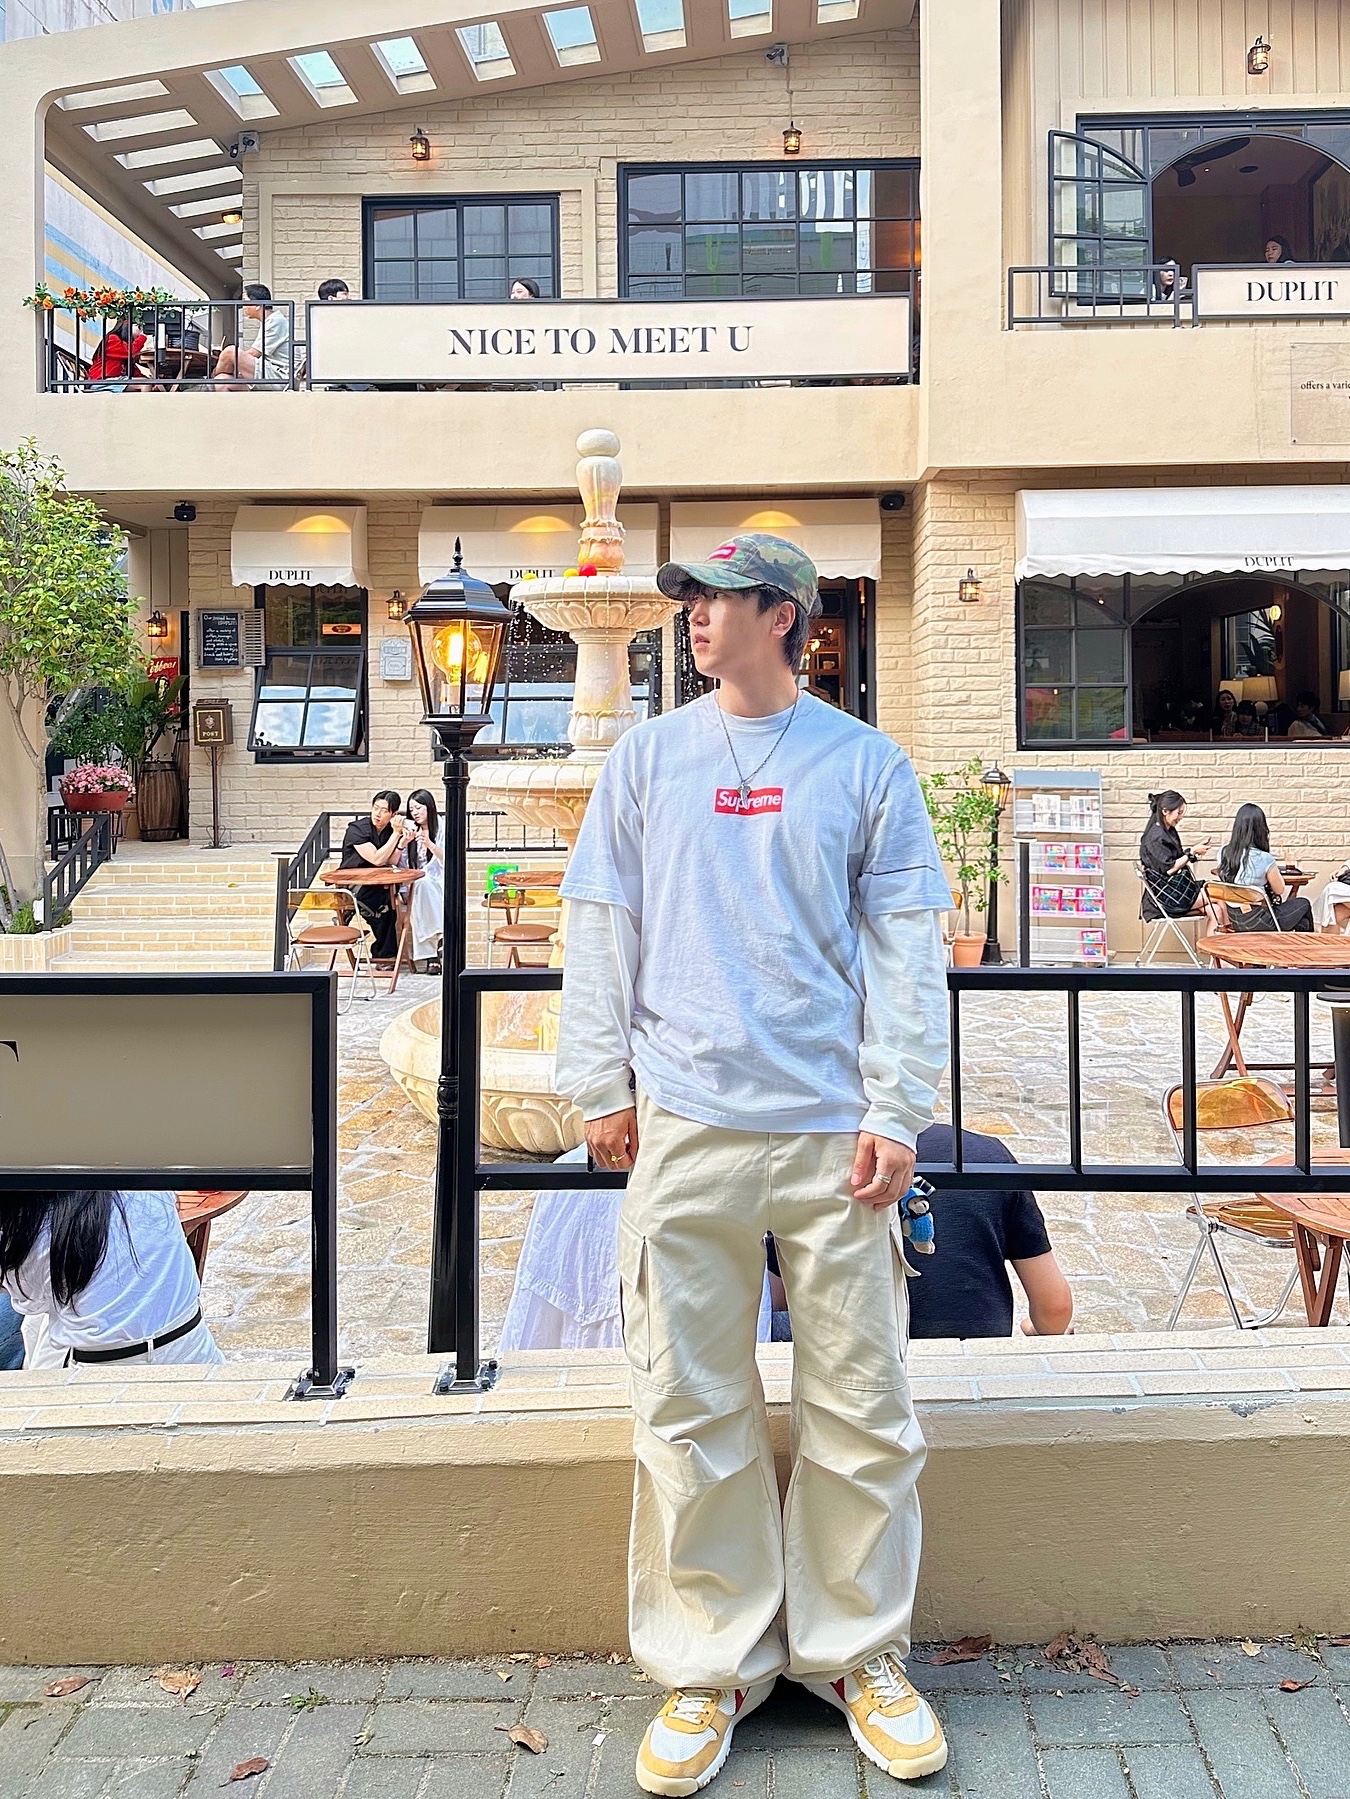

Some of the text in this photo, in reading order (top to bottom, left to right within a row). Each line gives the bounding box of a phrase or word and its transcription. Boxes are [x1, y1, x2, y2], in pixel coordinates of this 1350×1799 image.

[1246, 281, 1339, 301] DUPLIT
[448, 325, 754, 355] NICE TO MEET U
[1300, 380, 1324, 390] offers
[1244, 556, 1295, 567] DUPLIT
[269, 570, 313, 581] DUPLIT
